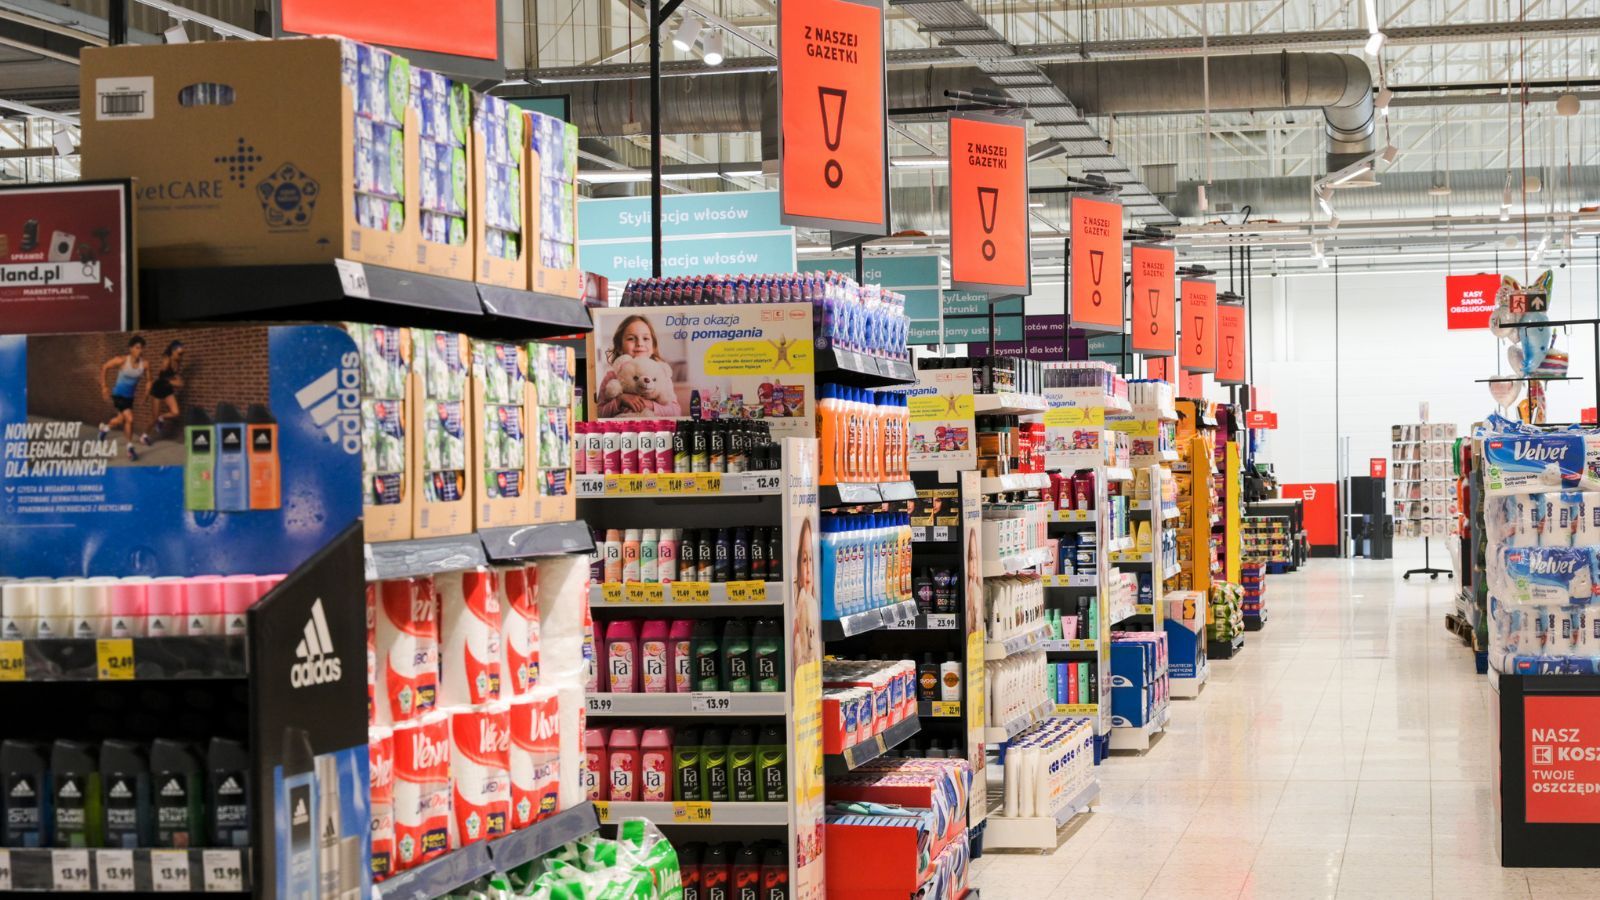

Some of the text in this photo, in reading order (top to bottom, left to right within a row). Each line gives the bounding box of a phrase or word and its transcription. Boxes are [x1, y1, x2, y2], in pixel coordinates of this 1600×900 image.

[804, 26, 858, 47] Z NASZEJ
[807, 44, 857, 64] GAZETKI
[967, 142, 1008, 157] Z NASZEJ
[968, 155, 1007, 169] GAZETKI
[619, 208, 748, 225] Styliacja włosów
[1083, 216, 1110, 228] Z NASZEJ
[1084, 226, 1110, 237] GAZETKI
[613, 250, 758, 271] Pielęnacja włosów
[23, 287, 73, 295] MARKETPLACE
[666, 313, 740, 328] Dobra okazja
[674, 326, 763, 342] do pomagania
[945, 328, 969, 337] jamy
[1045, 346, 1069, 354] kotó
[338, 351, 361, 455] adidas
[5, 421, 82, 440] NOWY START
[5, 440, 118, 462] PIELĘGNACJI CIAŁA
[1514, 440, 1569, 461] Velvet
[5, 459, 108, 478] DLA AKTYWNYCH
[582, 481, 603, 492] 11.49
[630, 480, 642, 491] 11.49
[669, 480, 681, 491] 11.49
[707, 479, 720, 490] 11.49
[757, 478, 780, 488] 12.49
[607, 546, 619, 558] Fa
[624, 546, 636, 558] Fa
[641, 546, 653, 557] Fa
[660, 546, 672, 557] Fa
[682, 545, 693, 557] Fa
[699, 545, 711, 557] Fa
[716, 545, 727, 557] Fa
[734, 545, 746, 557] Fa
[751, 544, 762, 556] Fa
[1529, 551, 1577, 574] Velvet
[613, 660, 628, 675] Fa
[647, 660, 662, 675] Fa
[701, 658, 715, 672] Fa
[731, 658, 746, 672] Fa
[760, 658, 774, 673] Fa
[291, 655, 342, 689] adidas
[589, 700, 612, 710] 13.99
[706, 699, 729, 709] 13.99
[1531, 728, 1580, 743] NASZ
[614, 771, 628, 786] Fa
[646, 771, 660, 786] Fa
[684, 768, 698, 782] Fa
[711, 768, 725, 782] Fa
[738, 767, 751, 782] Fa
[767, 767, 781, 782] Fa
[1532, 770, 1575, 781] TWOJE
[697, 808, 711, 819] 13.99
[61, 868, 88, 880] 13.99
[105, 868, 133, 880] 13.99
[161, 868, 188, 880] 13.99
[213, 868, 240, 880] 13.99
[684, 888, 698, 900] Fa
[710, 888, 724, 900] Fa
[741, 888, 755, 900] Fa
[770, 889, 784, 900] Fa
